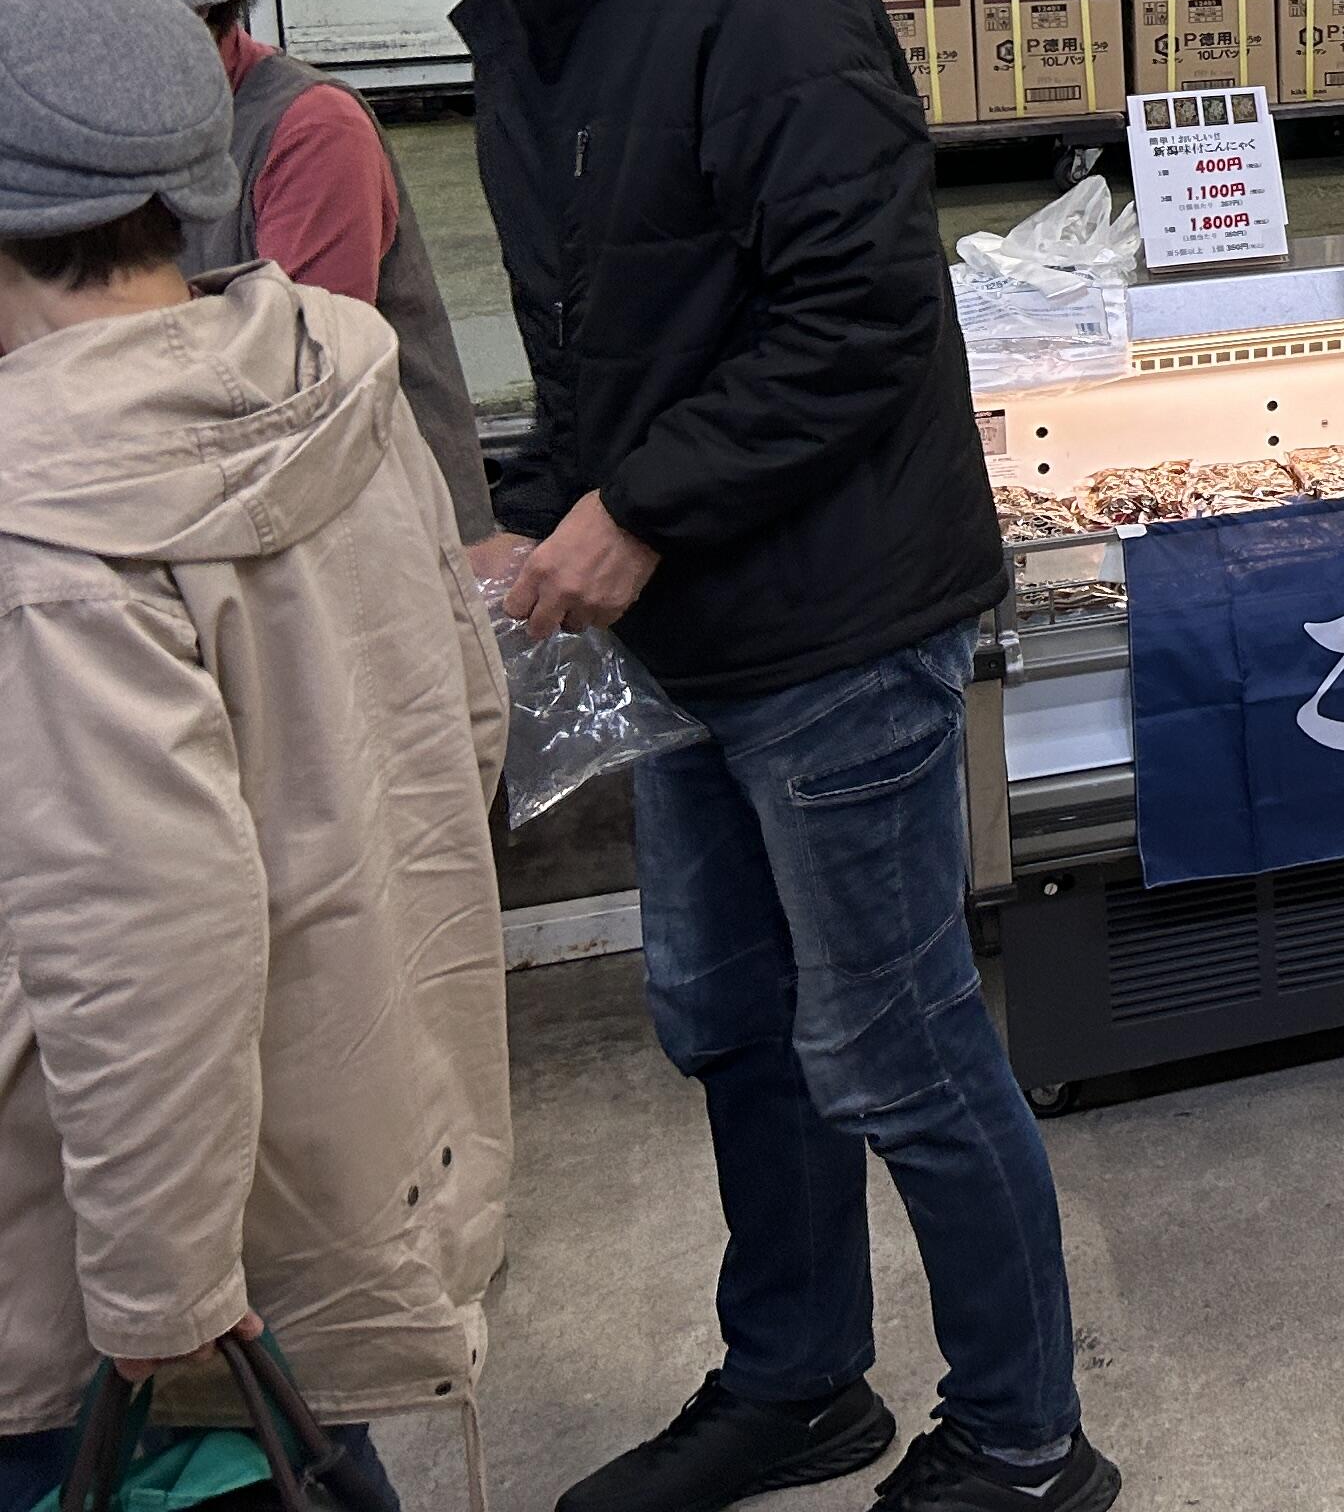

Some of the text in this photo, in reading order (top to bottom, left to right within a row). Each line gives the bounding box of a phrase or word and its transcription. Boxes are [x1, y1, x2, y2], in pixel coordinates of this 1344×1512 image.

[1153, 138, 1256, 157] 新潟味付こんにゃく
[1195, 156, 1243, 173] 400円
[1187, 182, 1246, 201] 1,100円
[1190, 212, 1250, 232] 1,800円
